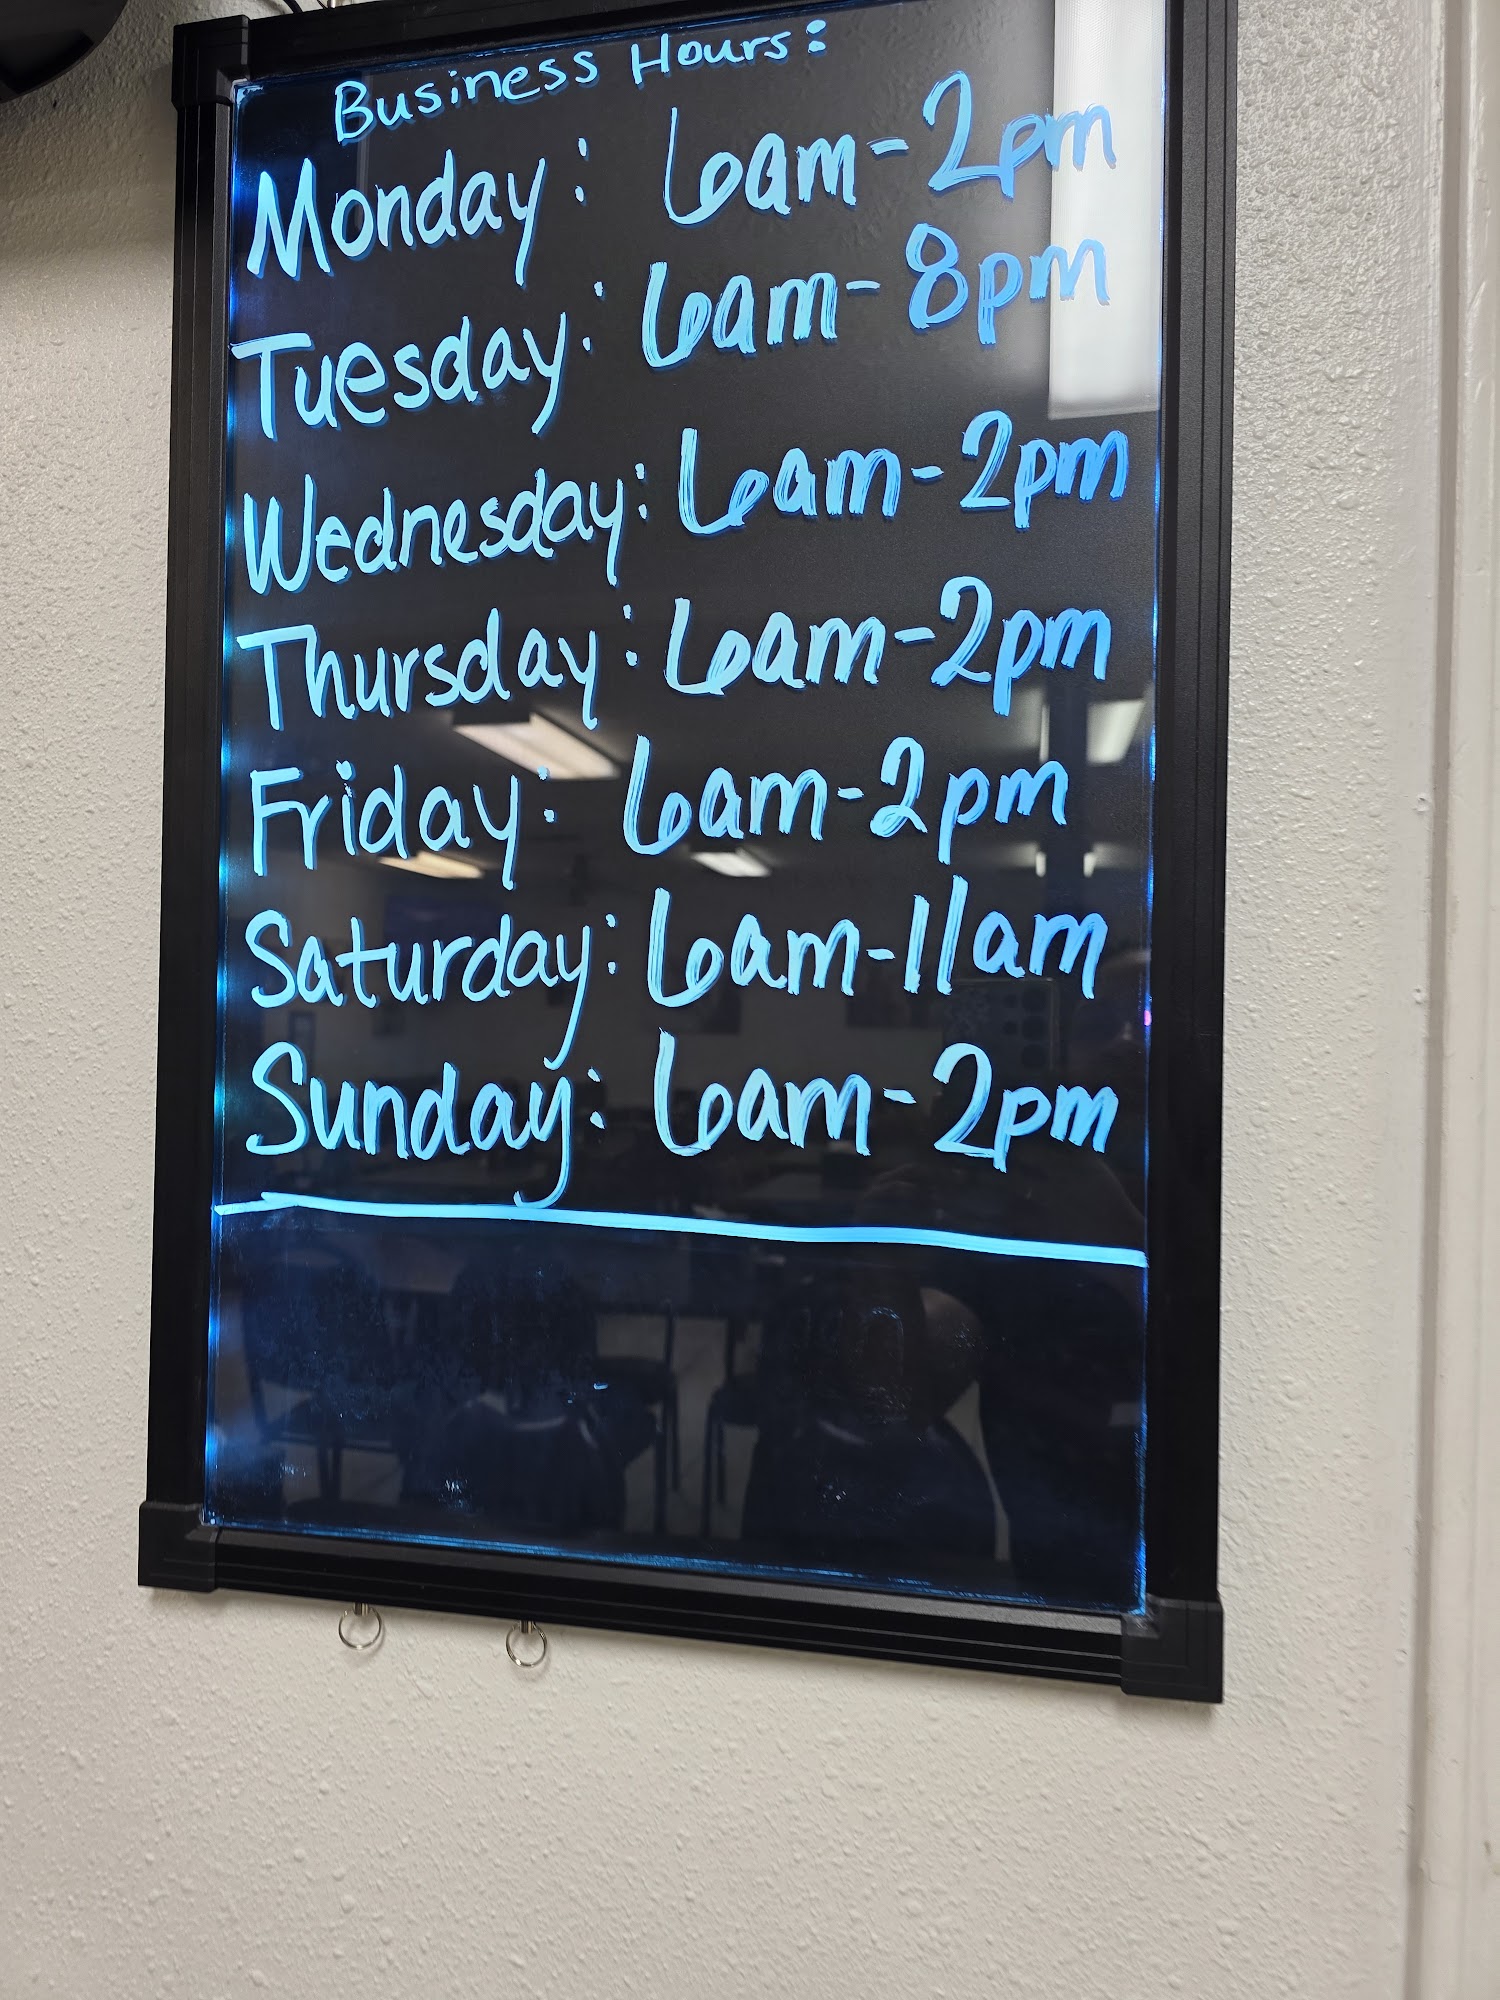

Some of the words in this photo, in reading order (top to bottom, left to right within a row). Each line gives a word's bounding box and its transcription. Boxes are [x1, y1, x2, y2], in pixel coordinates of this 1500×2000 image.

[333, 49, 599, 143] Business
[629, 18, 829, 86] Hours:
[246, 136, 590, 287] Monday:
[230, 280, 605, 442] Tuesday:
[242, 462, 648, 595] Wednesday:
[236, 606, 639, 731] Thursday:
[249, 759, 556, 892] Friday:
[244, 910, 618, 1072] Saturday:
[244, 1040, 606, 1208] Sunday:
